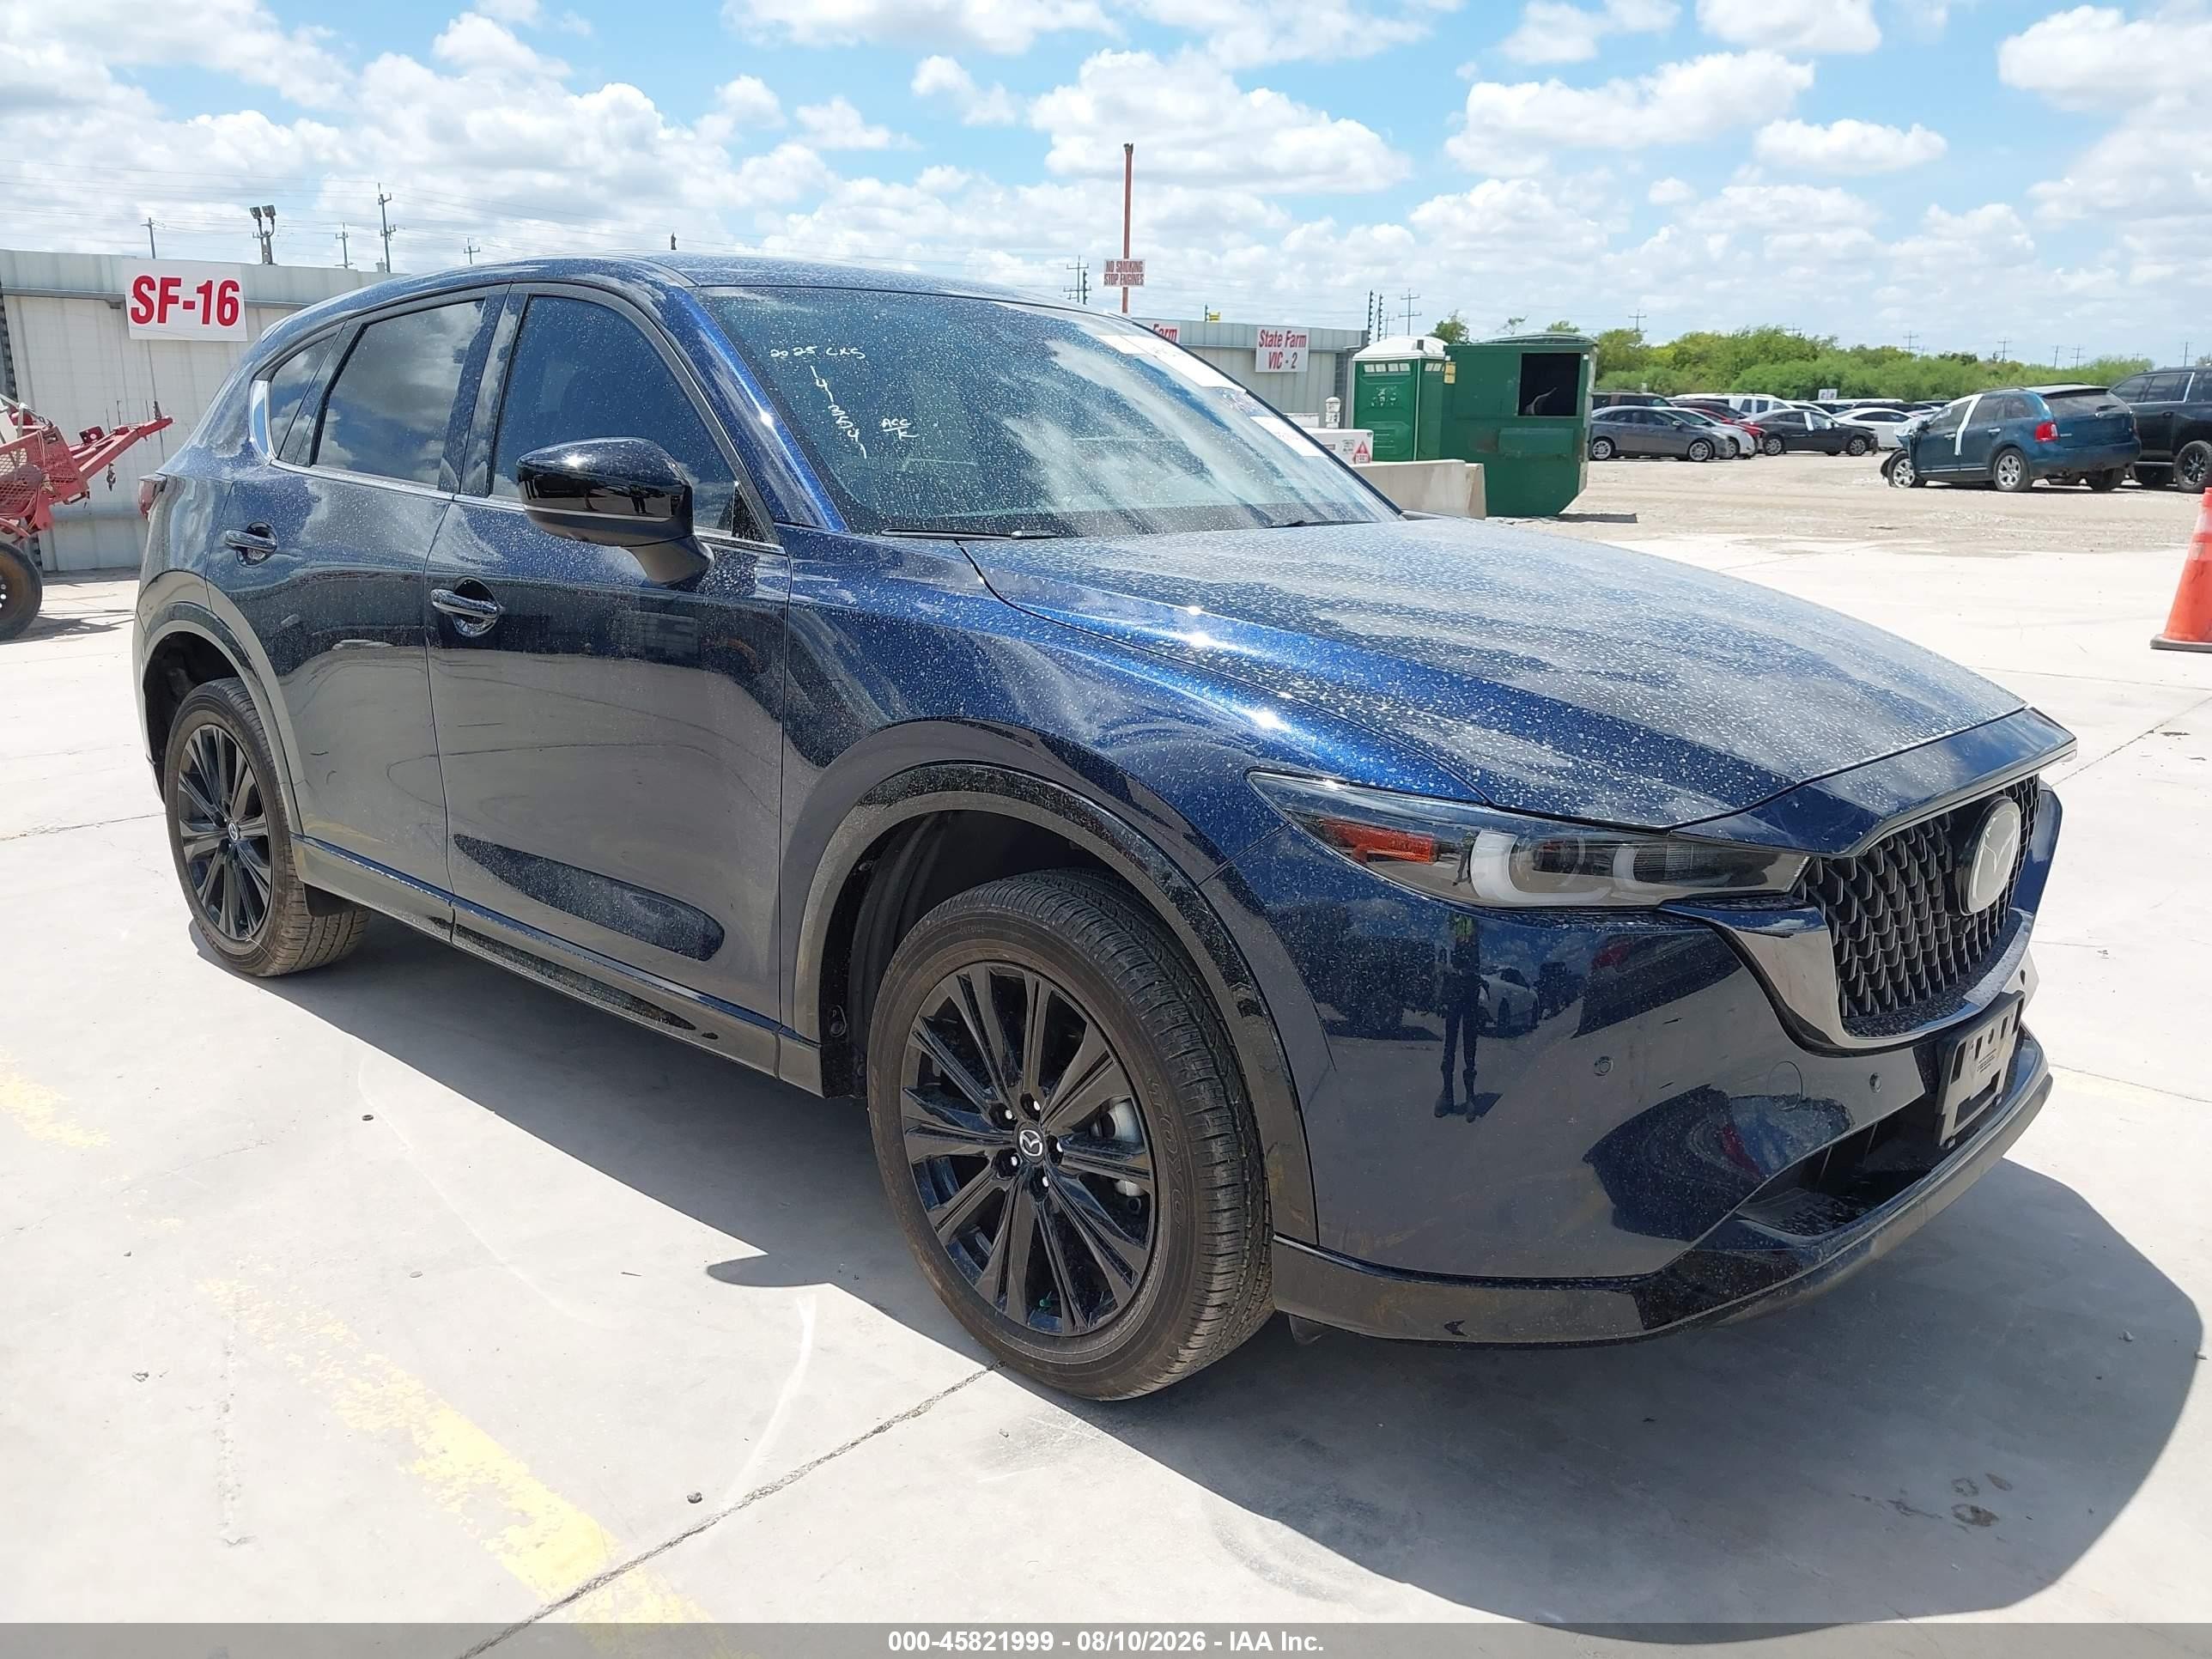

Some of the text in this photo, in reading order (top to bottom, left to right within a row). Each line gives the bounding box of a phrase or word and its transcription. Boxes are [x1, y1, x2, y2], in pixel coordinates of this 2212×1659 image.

[1106, 260, 1143, 273] NO SMOKING
[1104, 273, 1144, 285] STOP ENGINES
[131, 275, 240, 326] SF-16
[1259, 329, 1307, 348] State Farm
[1268, 351, 1284, 369] VIC
[1291, 351, 1297, 369] 2
